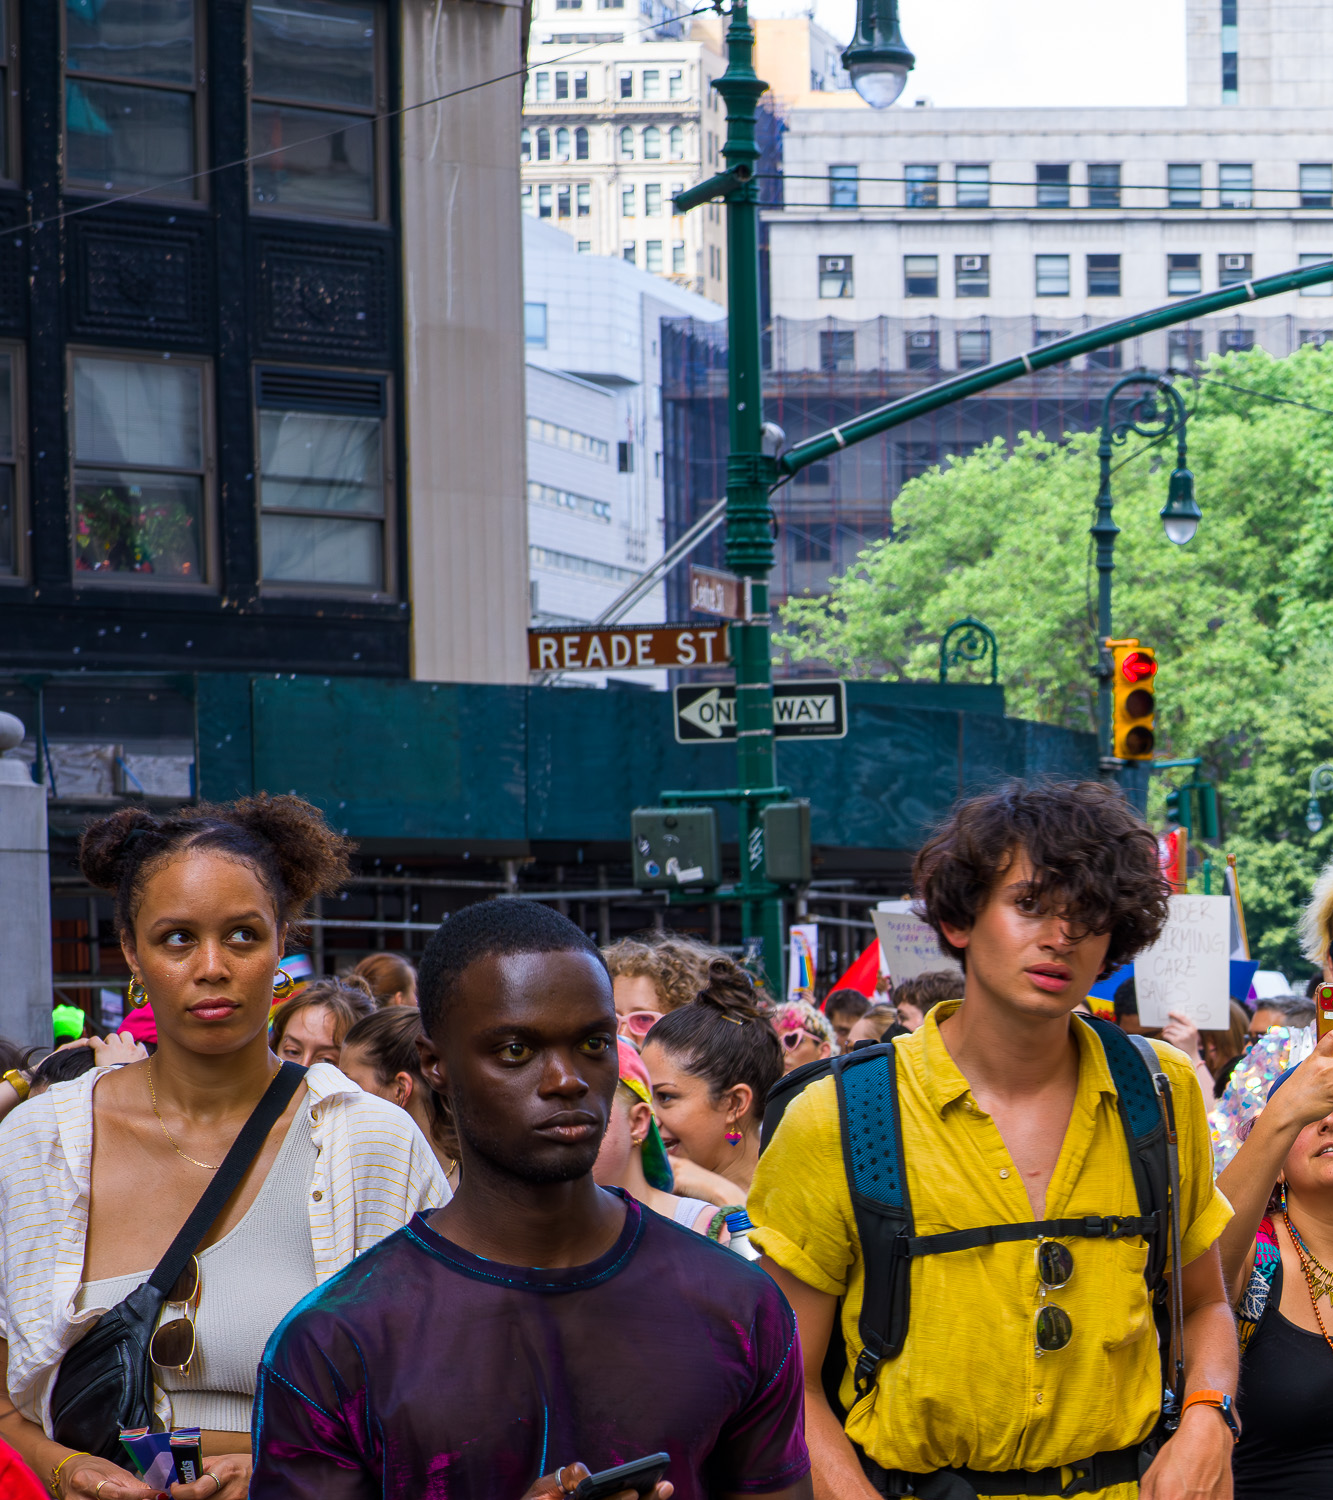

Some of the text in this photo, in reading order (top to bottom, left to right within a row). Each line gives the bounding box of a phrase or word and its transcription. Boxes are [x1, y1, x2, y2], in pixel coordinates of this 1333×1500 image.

[538, 631, 717, 669] READE ST
[699, 698, 830, 723] ON WAY
[1153, 954, 1197, 978] CARE
[1139, 977, 1190, 1005] SAVES
